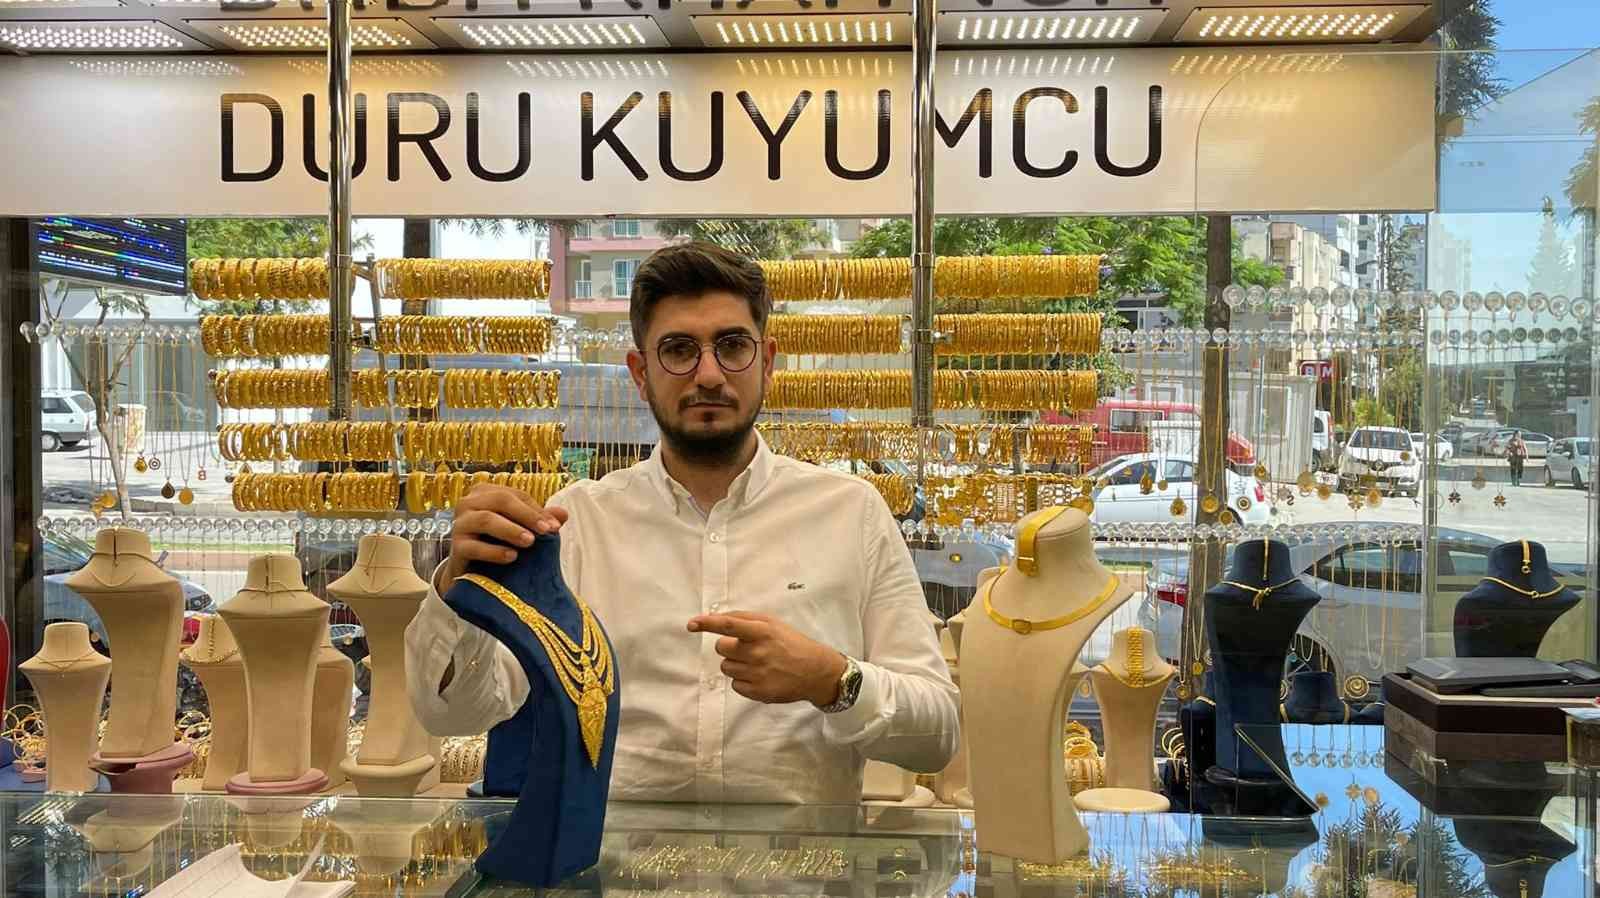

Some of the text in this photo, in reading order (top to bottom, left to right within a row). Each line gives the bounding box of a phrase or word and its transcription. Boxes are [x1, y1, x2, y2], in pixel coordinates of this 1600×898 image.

[221, 85, 1162, 182] DURU KUYUMCU
[1305, 366, 1335, 378] BM
